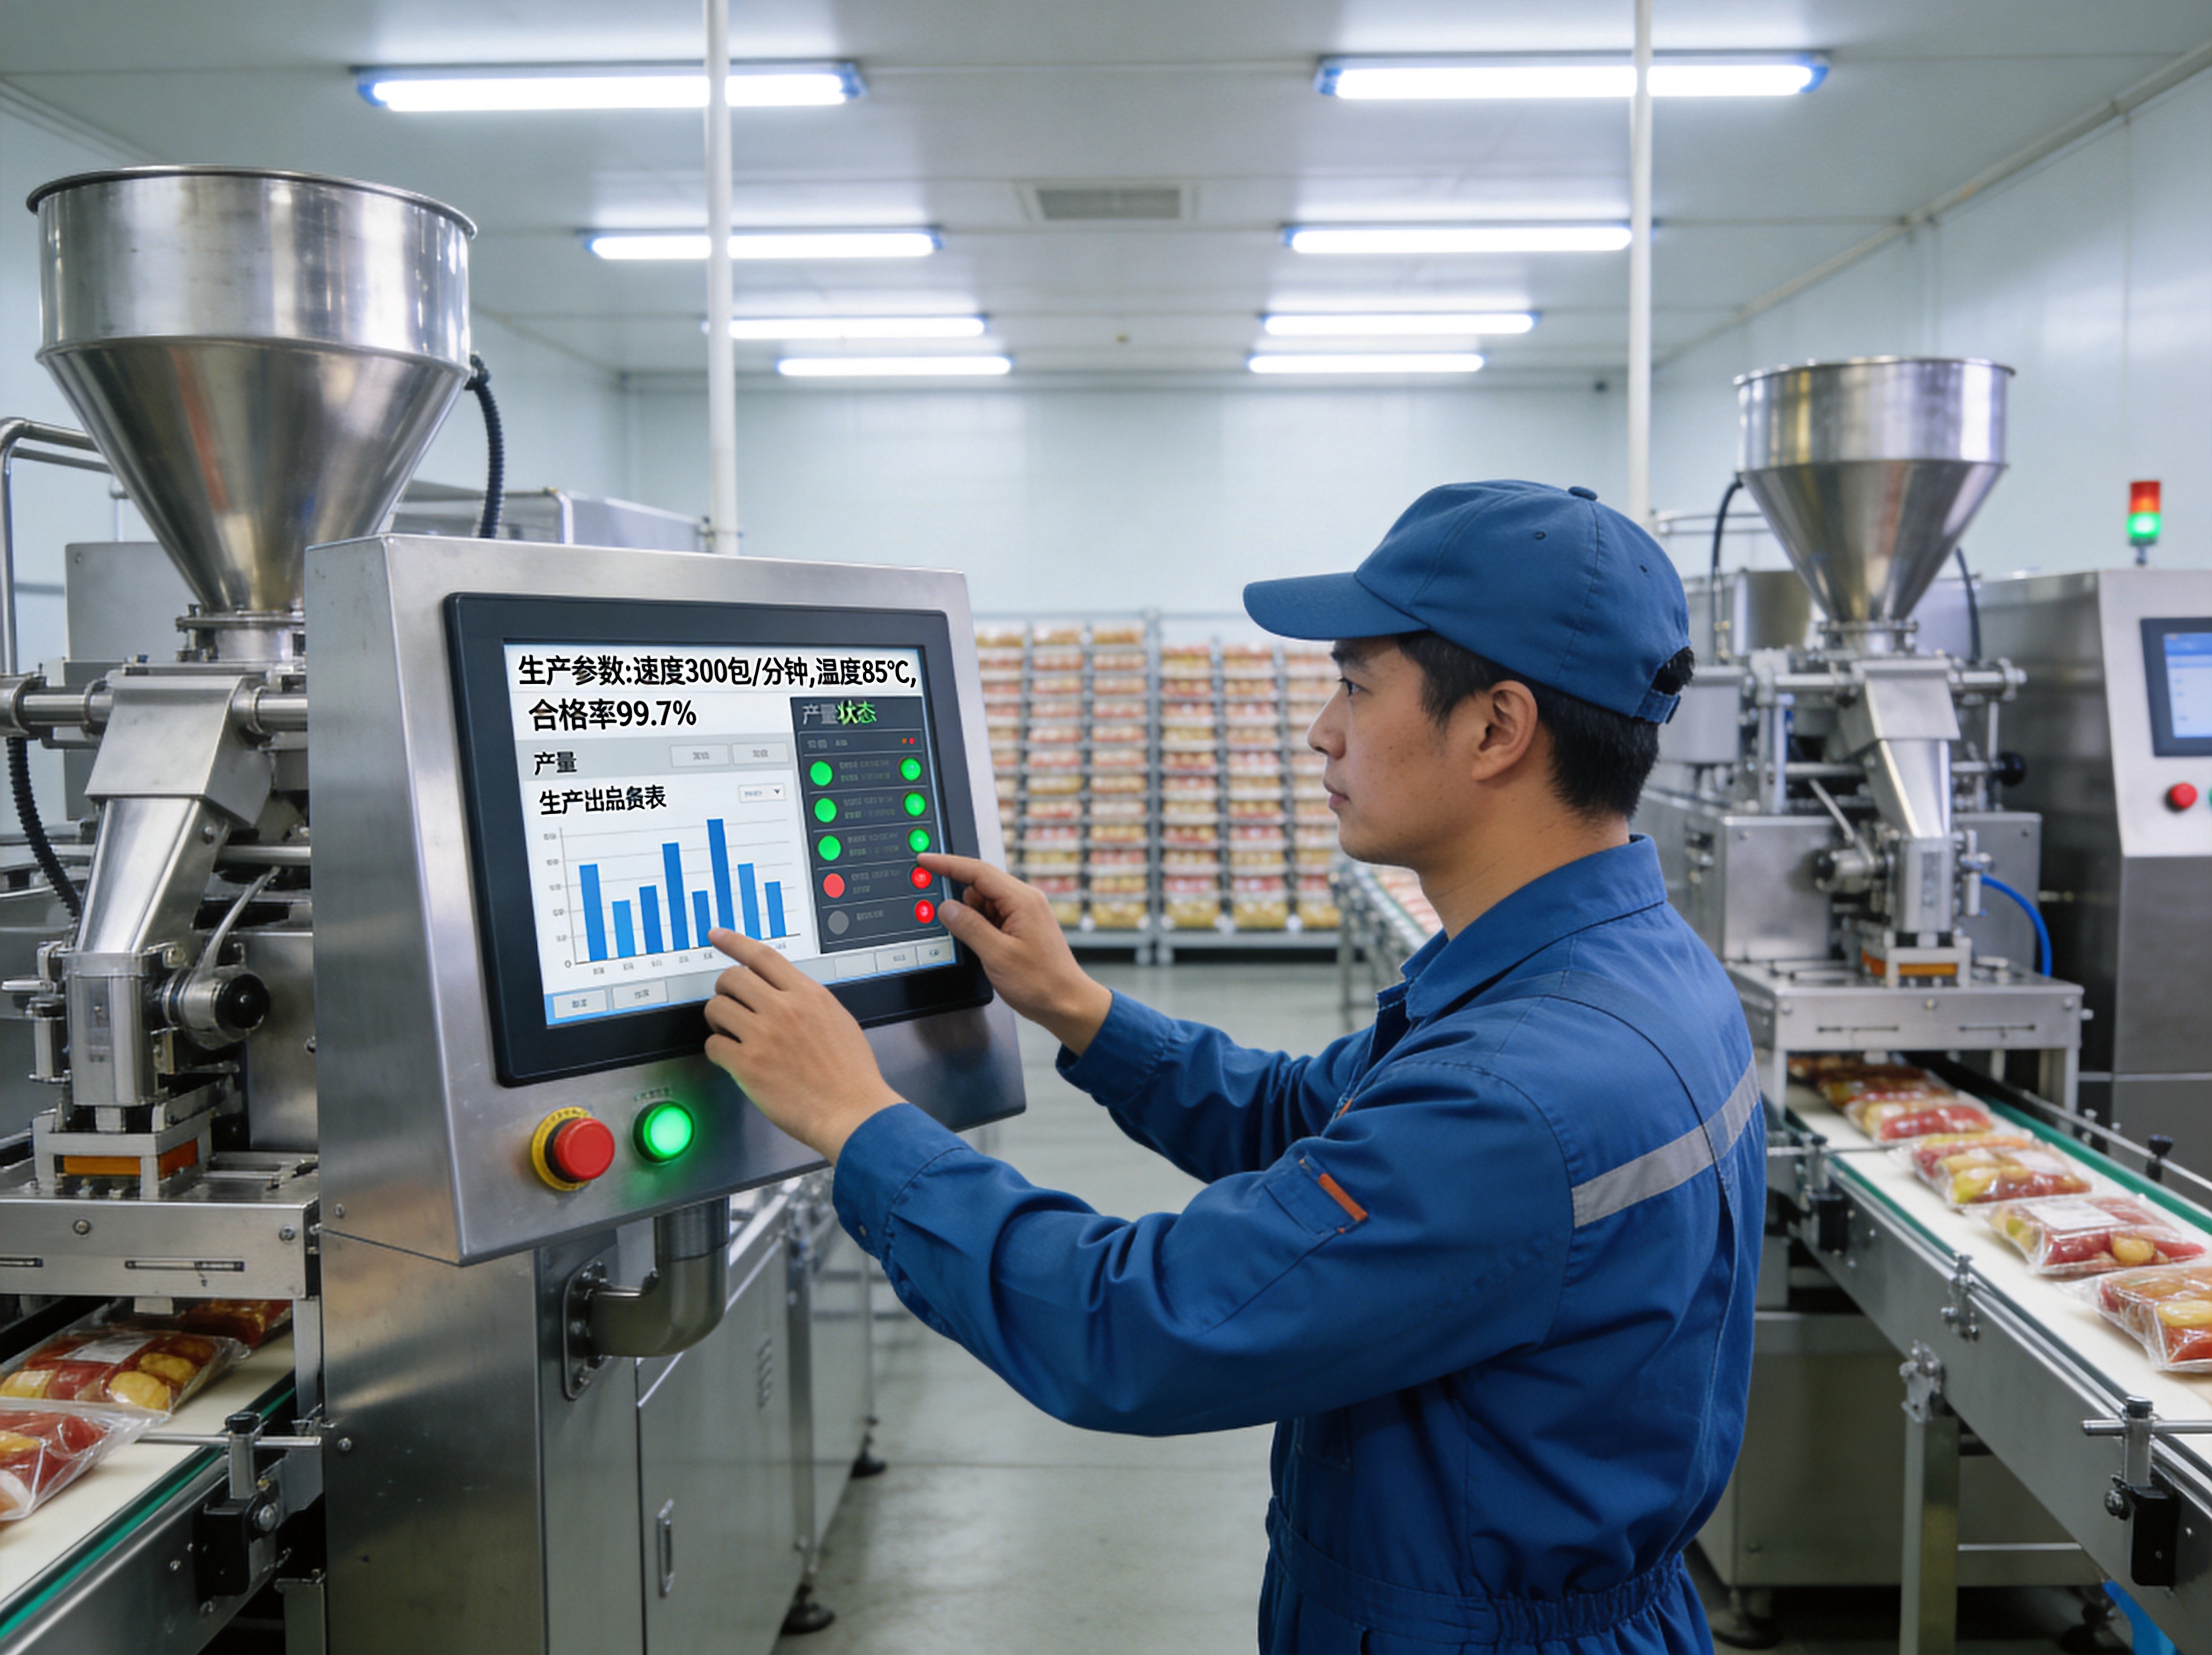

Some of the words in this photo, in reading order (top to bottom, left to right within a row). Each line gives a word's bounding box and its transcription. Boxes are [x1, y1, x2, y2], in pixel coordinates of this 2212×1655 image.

[528, 698, 697, 731] 合格率99.7%
[533, 751, 577, 775] 产量
